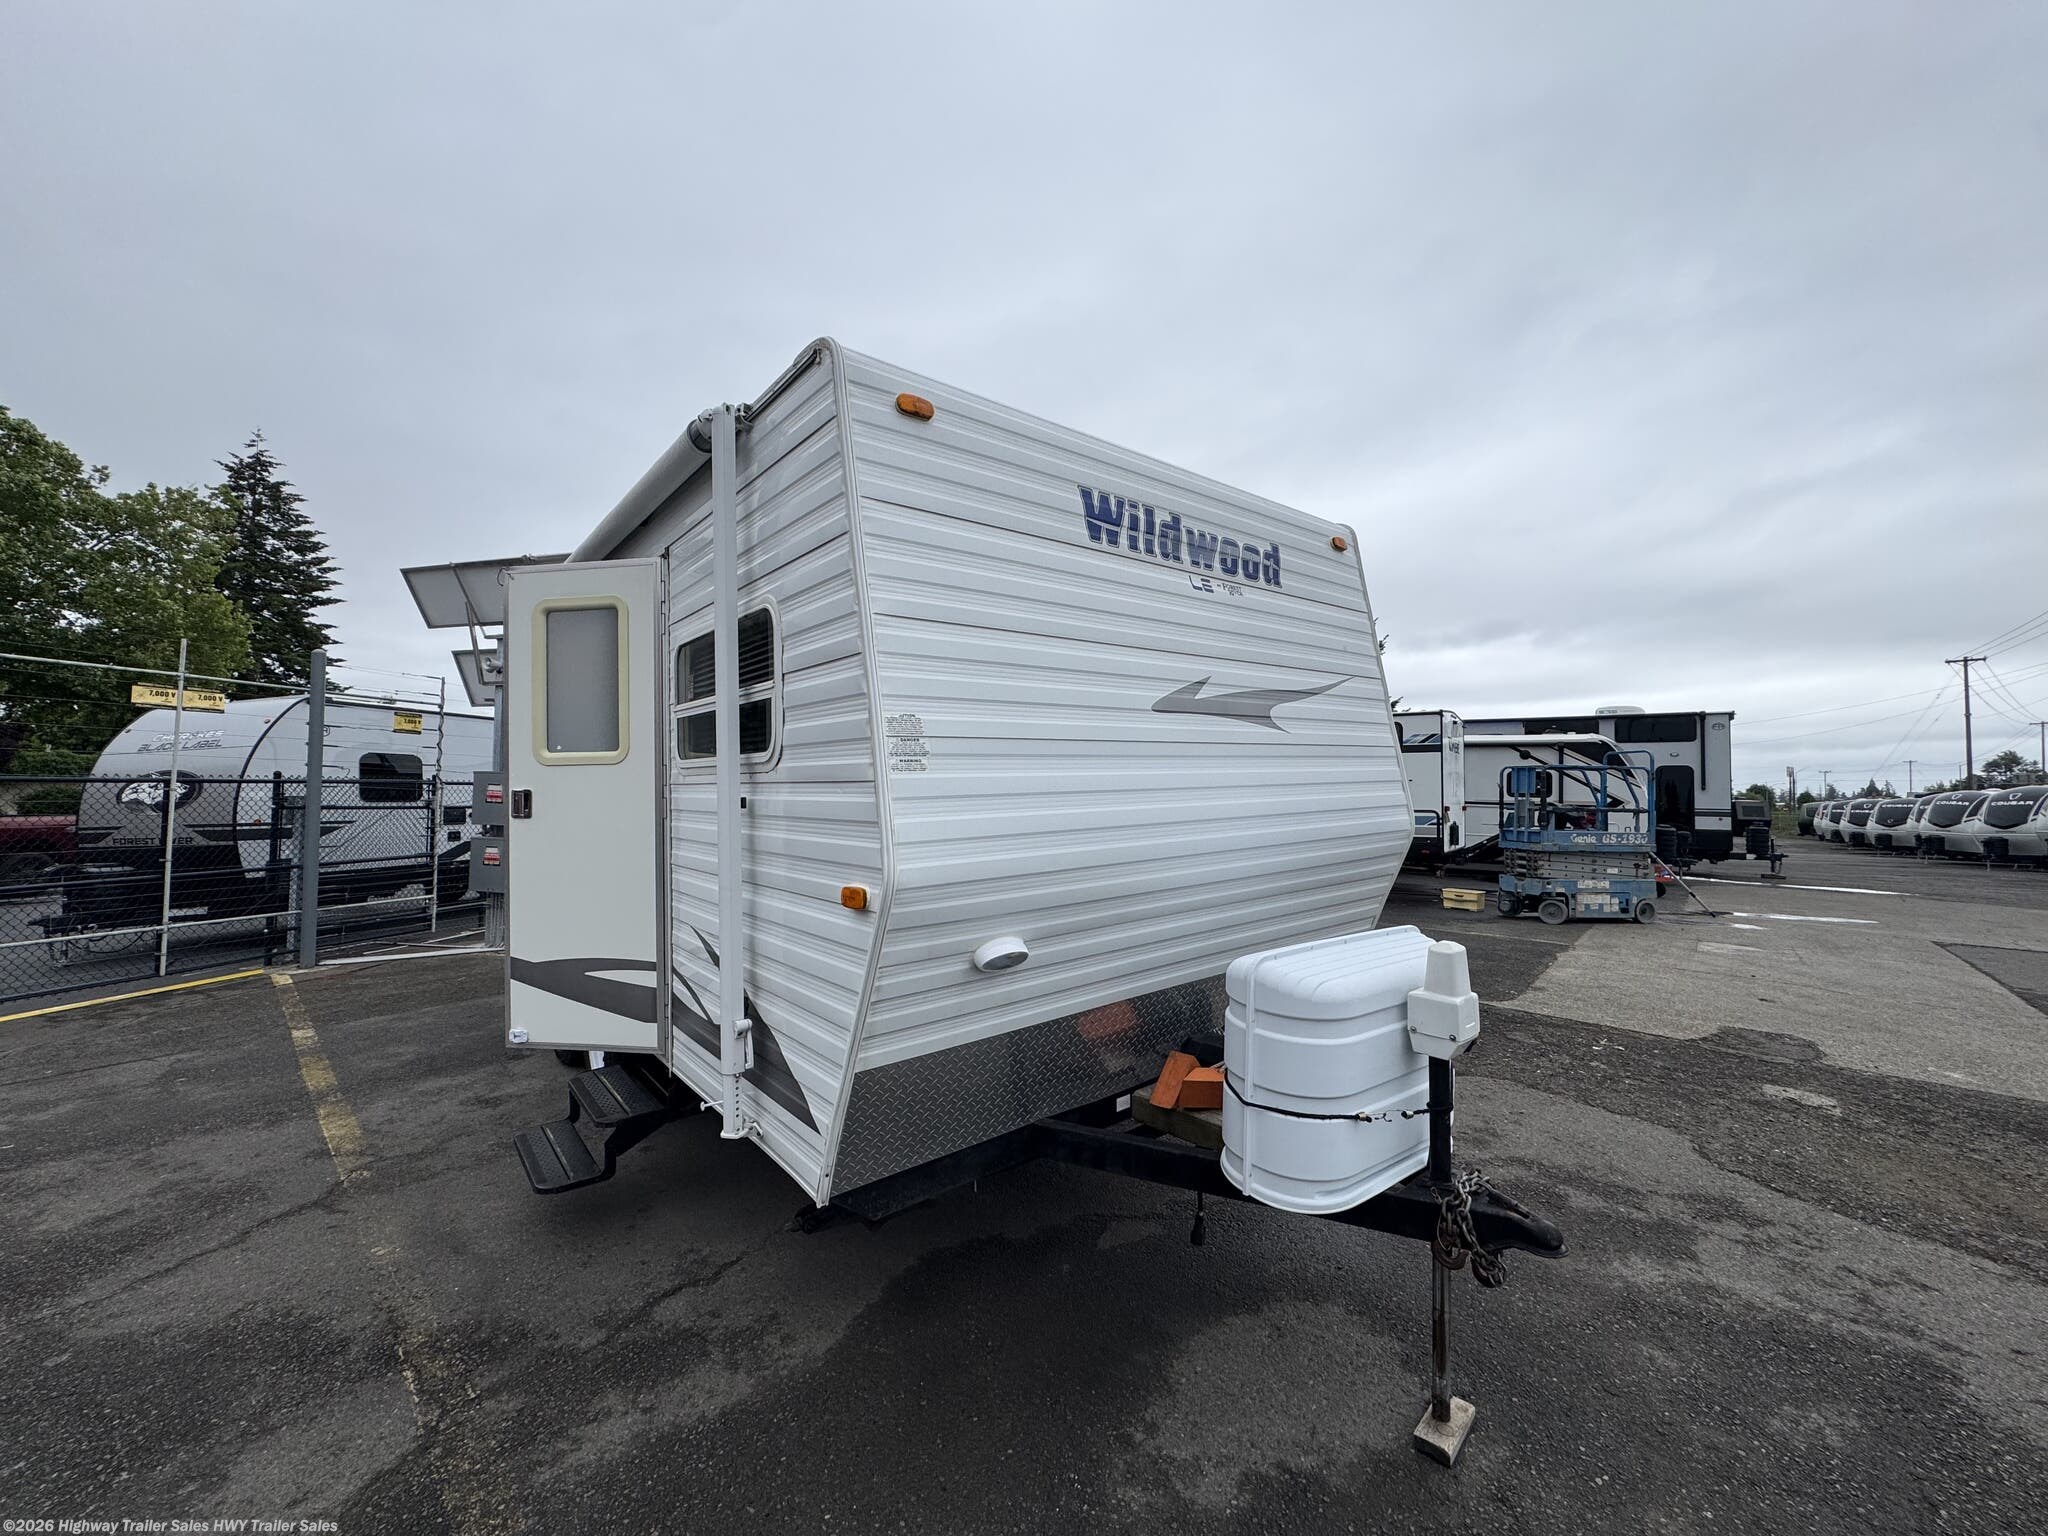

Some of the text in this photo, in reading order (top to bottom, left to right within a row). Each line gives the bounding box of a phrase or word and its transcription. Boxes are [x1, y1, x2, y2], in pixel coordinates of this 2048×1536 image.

[1077, 485, 1282, 588] Wildwood
[1189, 575, 1214, 593] LE
[149, 689, 170, 698] 7,000
[198, 694, 217, 702] 7,000
[182, 739, 222, 749] LABEL
[112, 837, 156, 845] FOREST
[1570, 833, 1597, 844] Genie
